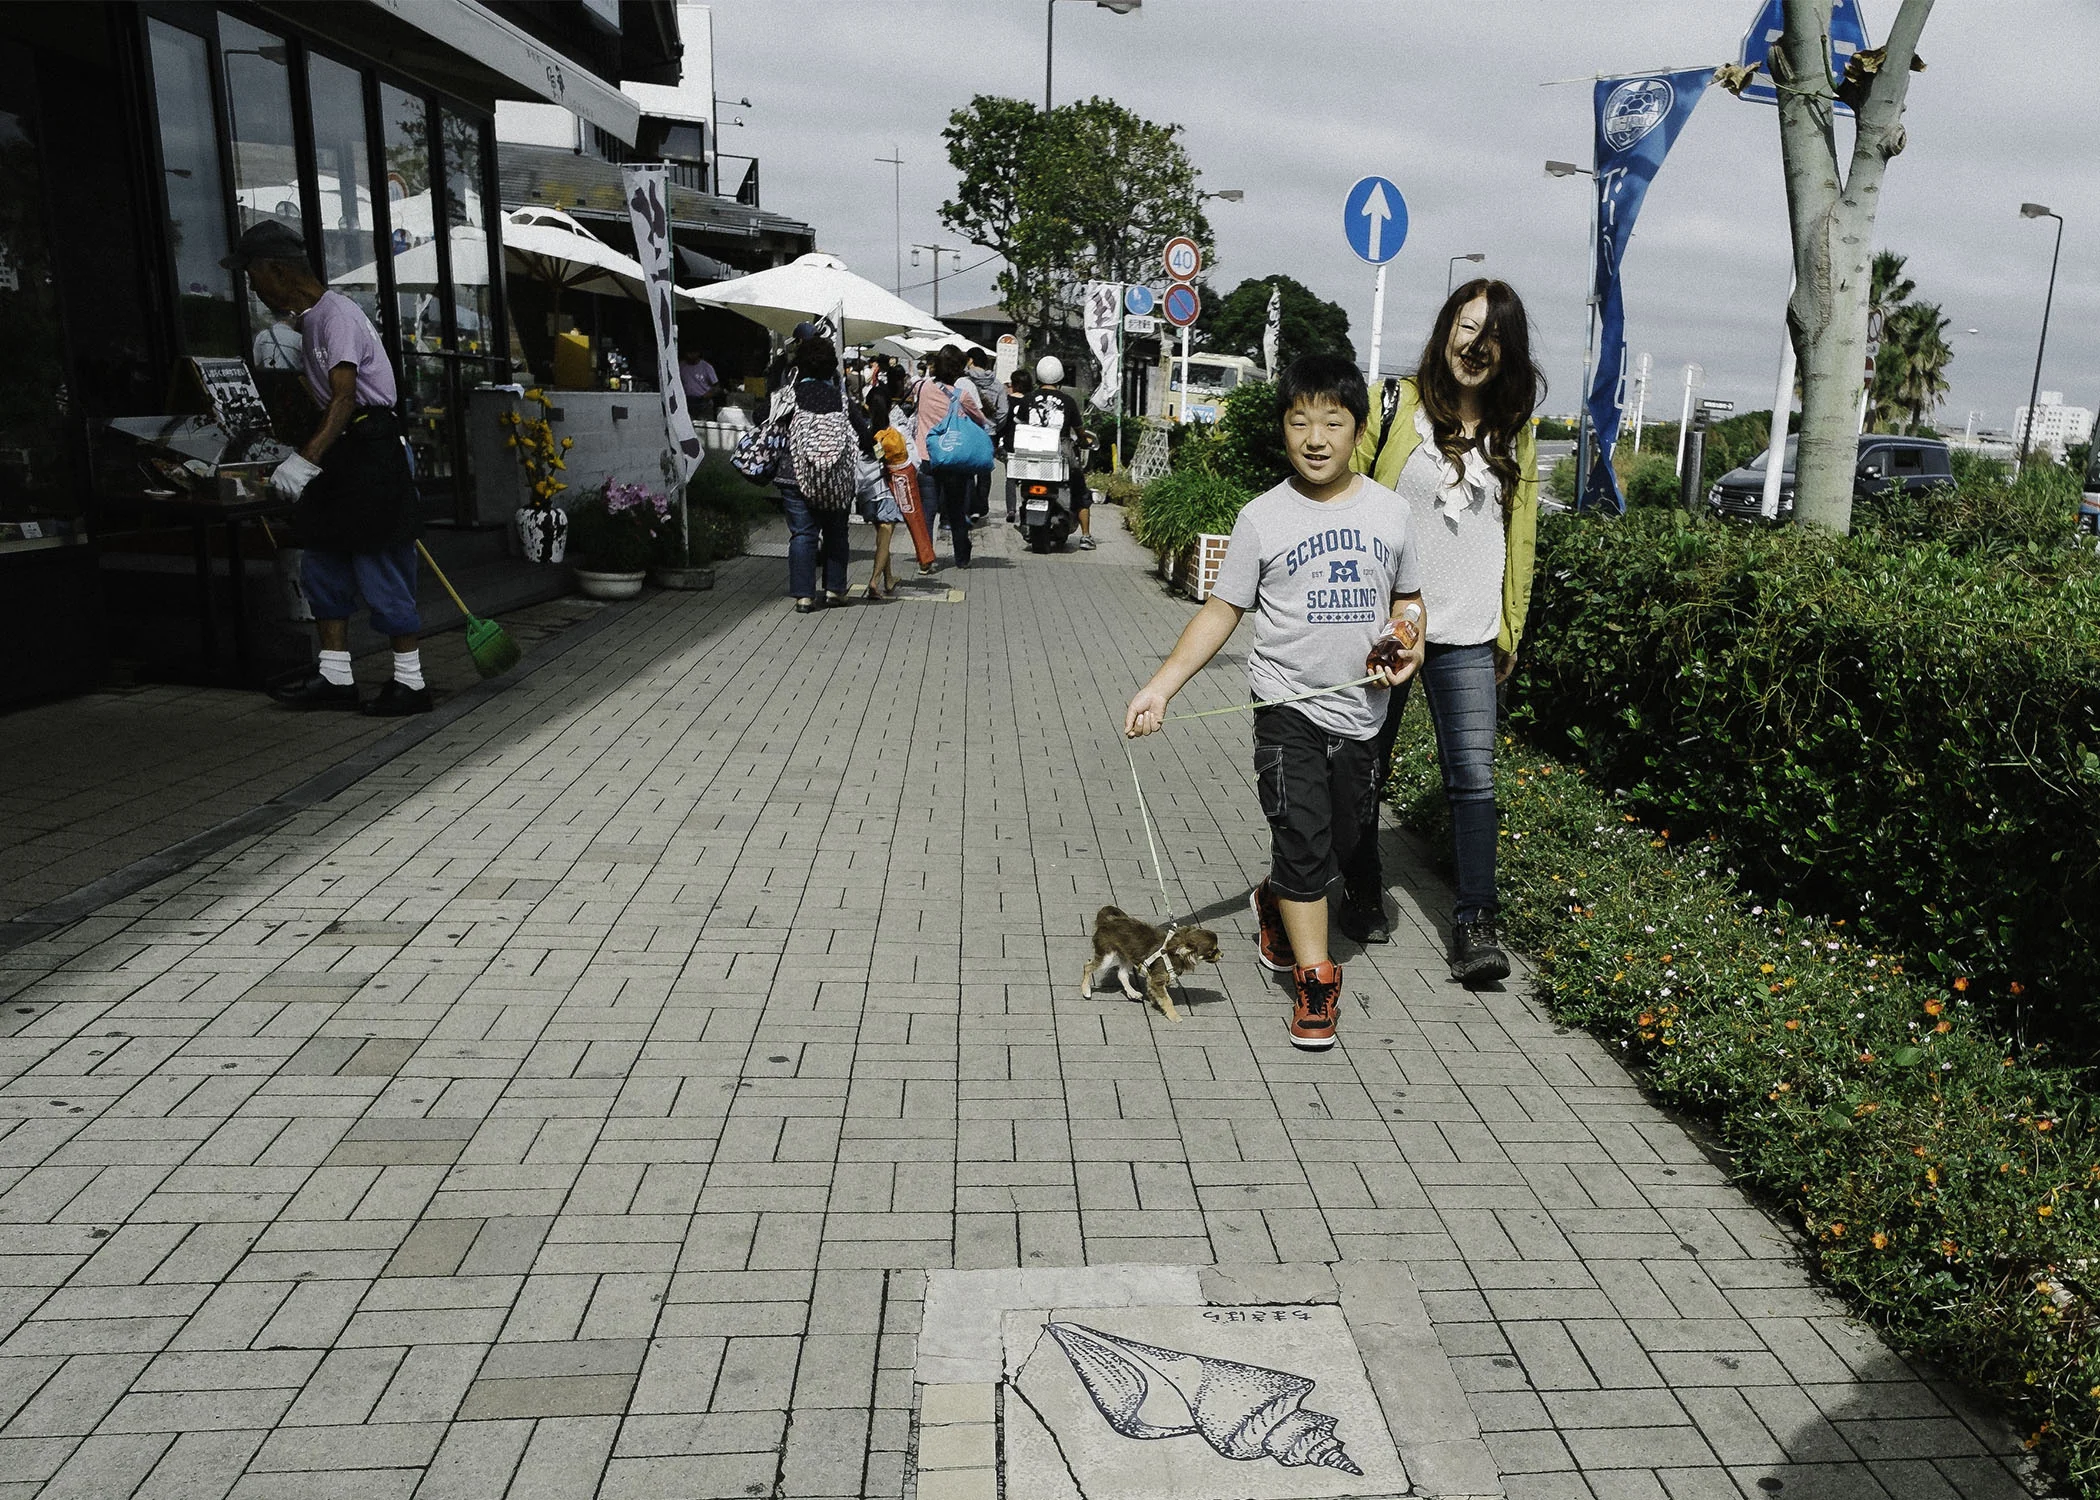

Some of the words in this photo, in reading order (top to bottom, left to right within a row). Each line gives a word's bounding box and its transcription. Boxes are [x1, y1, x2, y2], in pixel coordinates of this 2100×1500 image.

[1173, 250, 1193, 269] 40
[1286, 528, 1366, 576] SCHOOL
[1373, 536, 1390, 568] OF
[1307, 588, 1377, 609] SCARING
[1203, 1310, 1312, 1325] ちまきぼら
